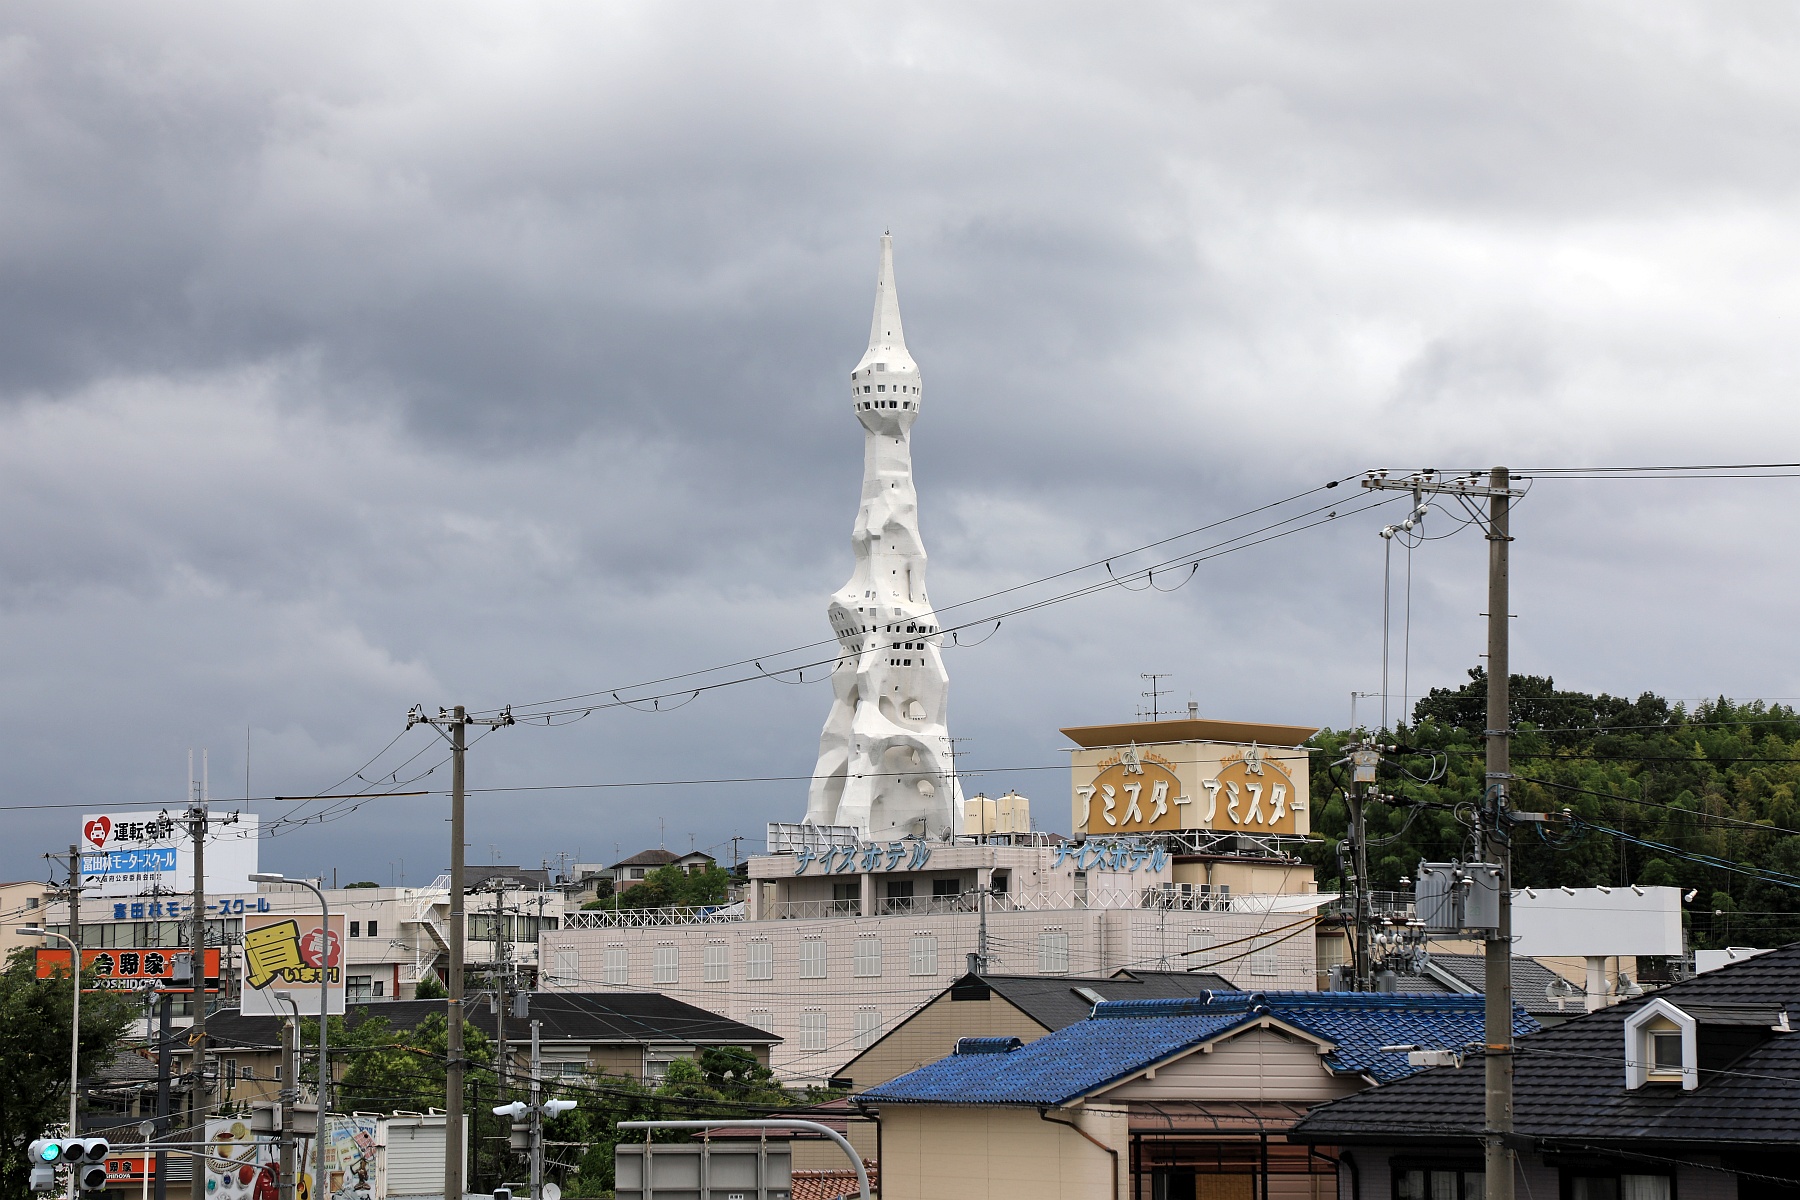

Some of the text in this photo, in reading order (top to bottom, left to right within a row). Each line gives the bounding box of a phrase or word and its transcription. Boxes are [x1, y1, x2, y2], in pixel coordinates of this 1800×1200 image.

[1075, 779, 1192, 829] アミスター
[1202, 778, 1306, 826] アミスター
[113, 821, 175, 841] 運転免許
[83, 851, 175, 872] 富田林モータースクール
[795, 839, 932, 875] ナイスホテル
[1051, 840, 1169, 873] ナイスホテル
[113, 897, 271, 919] 富田林モーースクール
